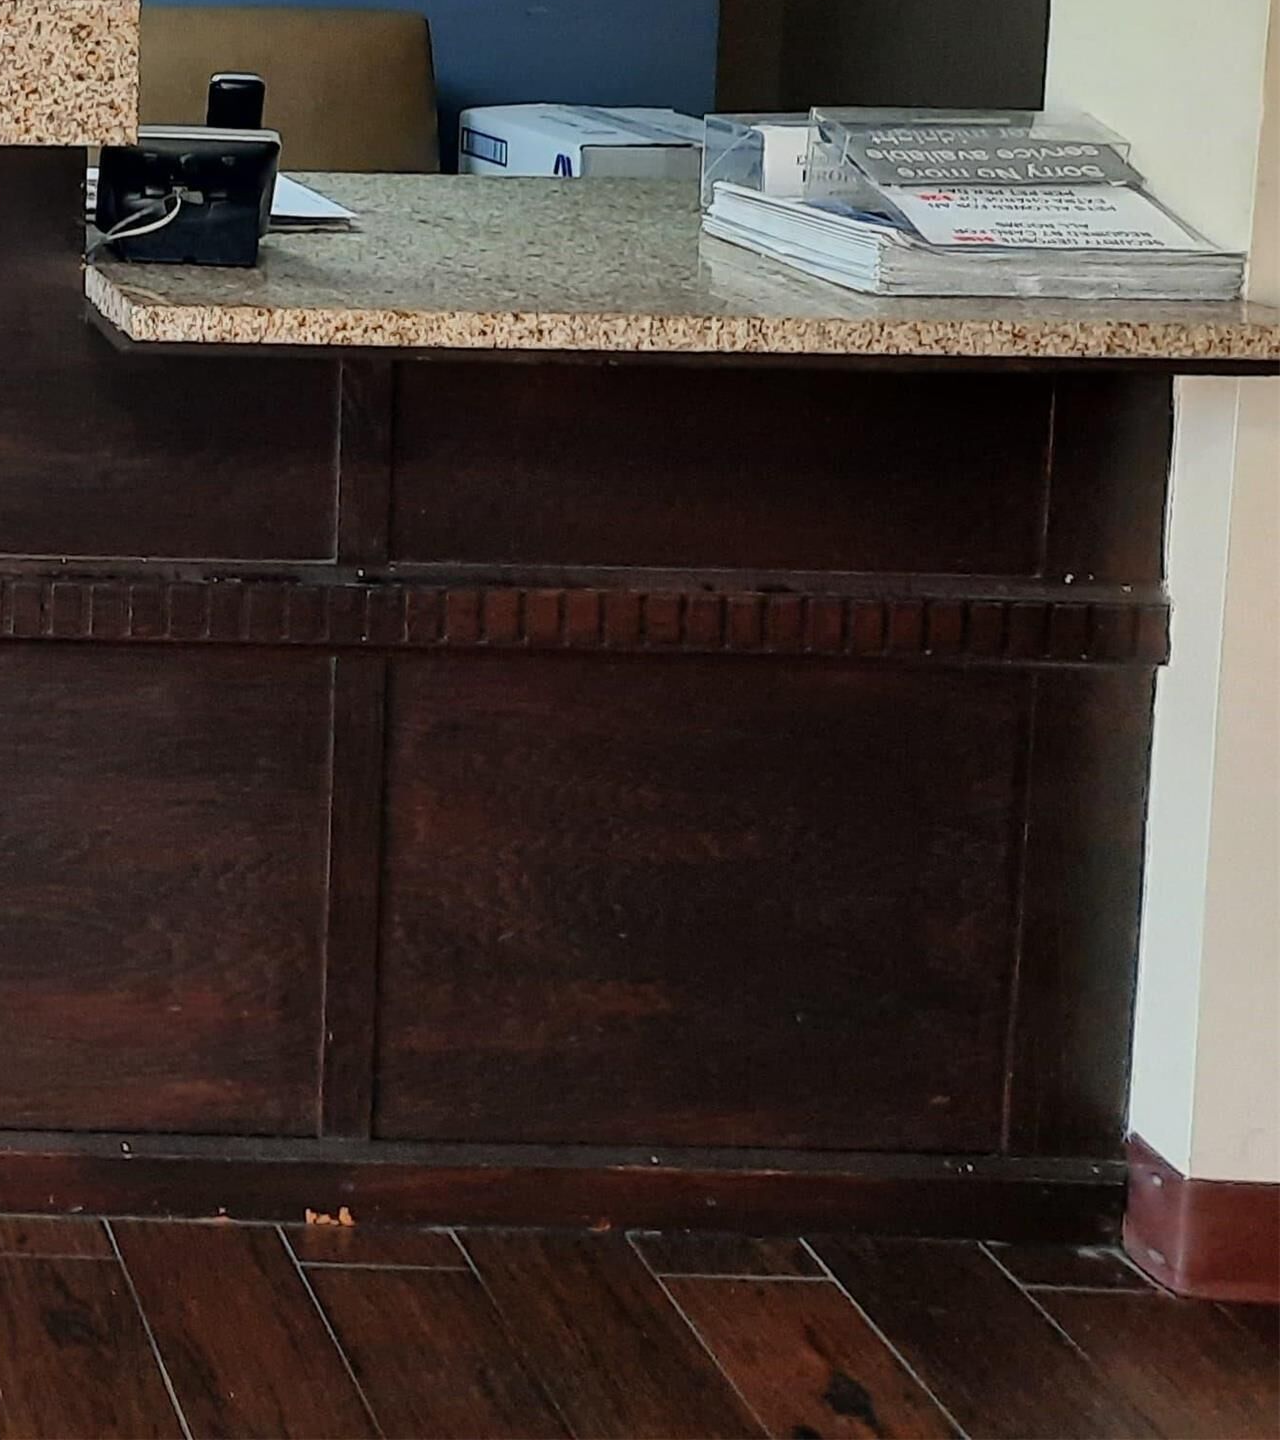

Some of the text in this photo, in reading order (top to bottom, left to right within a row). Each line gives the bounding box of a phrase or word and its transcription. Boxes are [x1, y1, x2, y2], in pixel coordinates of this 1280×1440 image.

[865, 145, 1099, 164] service available
[897, 163, 1105, 180] Sorry No more
